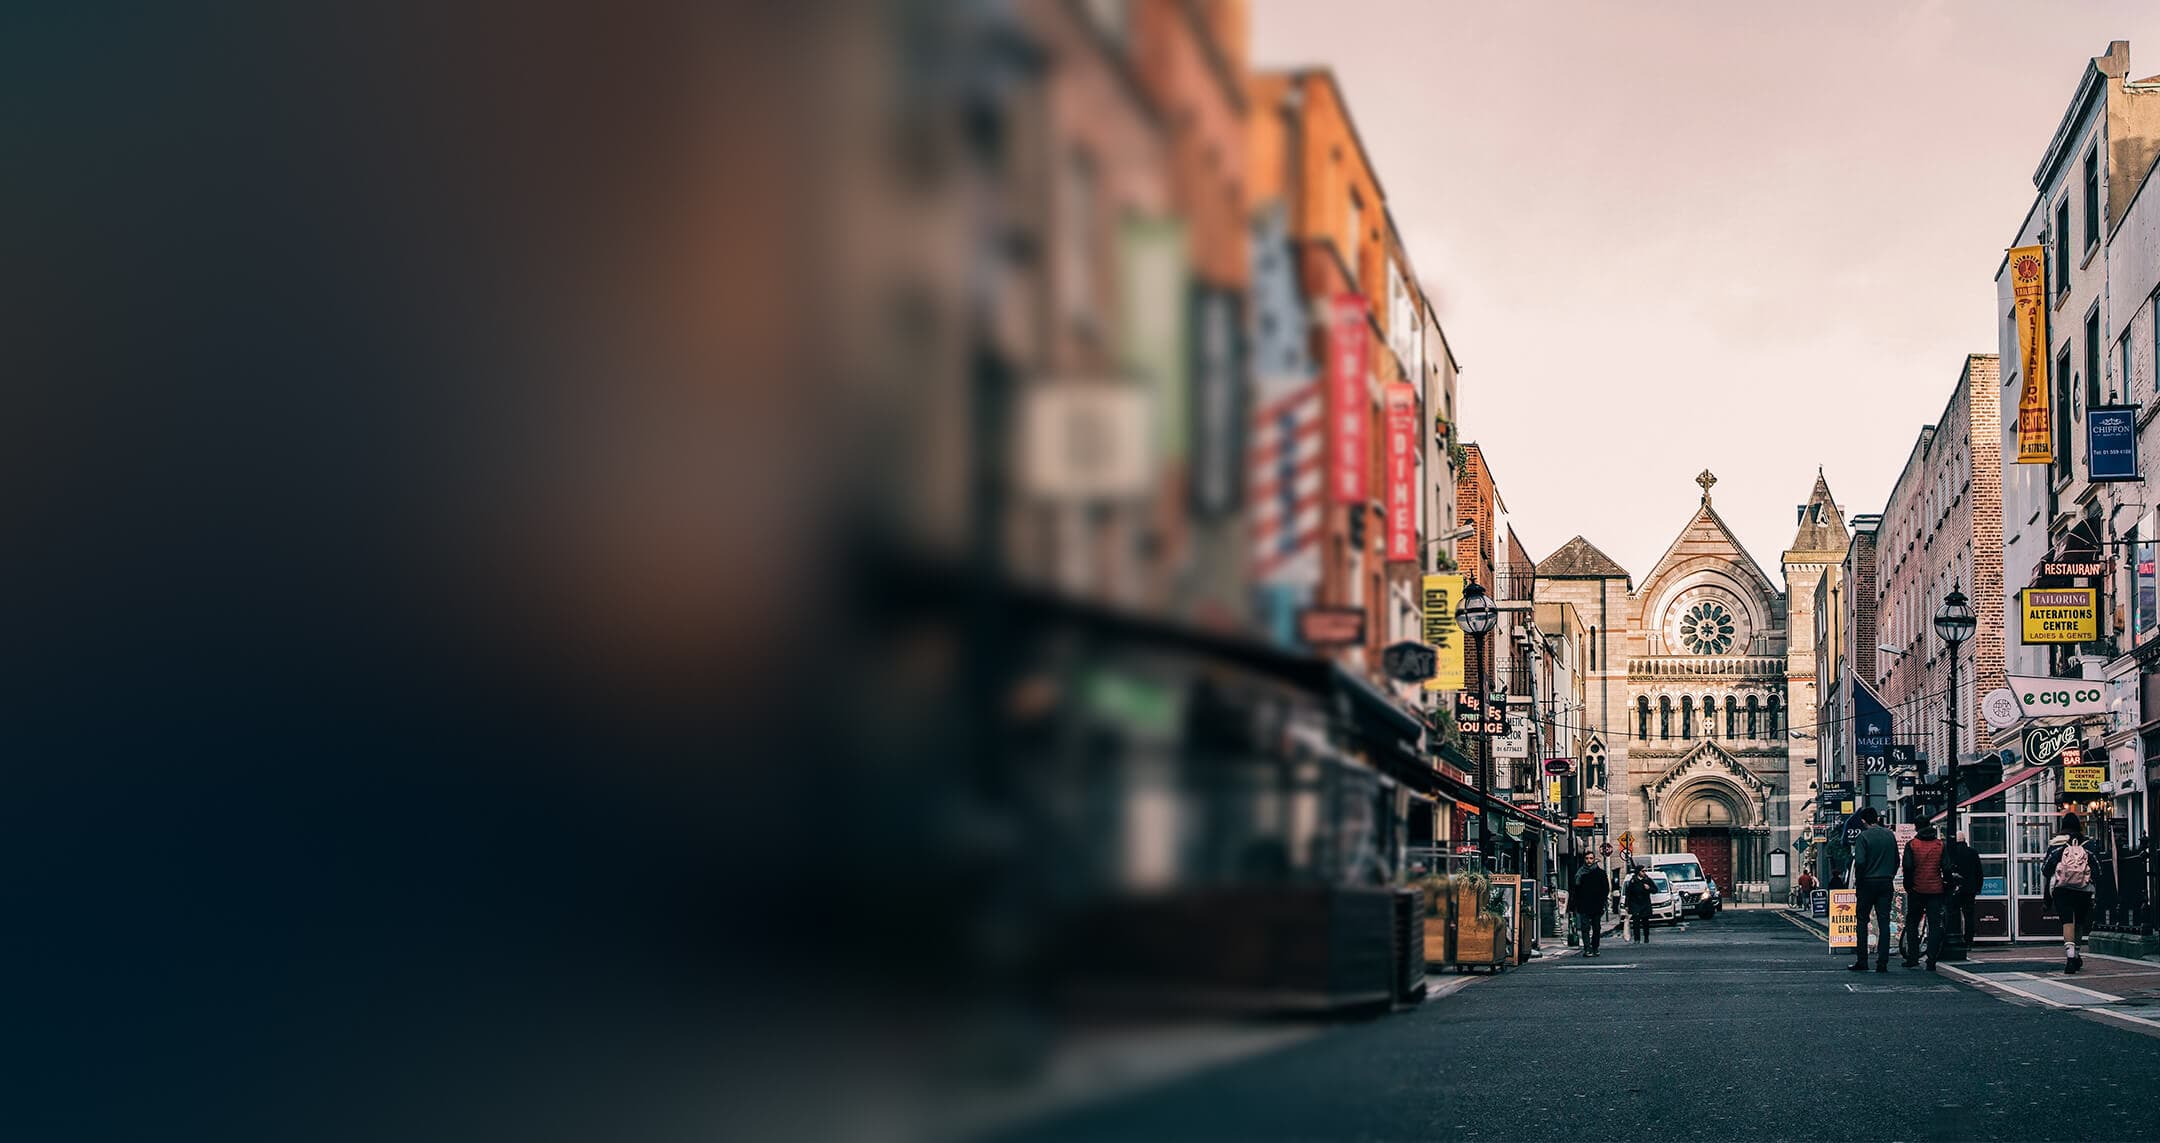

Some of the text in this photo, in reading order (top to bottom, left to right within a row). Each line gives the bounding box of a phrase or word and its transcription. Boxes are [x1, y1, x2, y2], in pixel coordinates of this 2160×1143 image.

[2028, 307, 2038, 404] ALTERATION
[2021, 411, 2048, 430] CENTRE
[1393, 432, 1409, 555] DINER
[2045, 563, 2101, 575] RESTAURANT
[2035, 595, 2086, 605] TAILORING
[2030, 610, 2092, 619] ALTERATIONS
[2043, 621, 2079, 630] CENTRE
[2024, 689, 2101, 707] e cig co
[1858, 737, 1891, 745] MAGEE
[1866, 756, 1886, 772] 22
[2063, 757, 2080, 765] BAR
[1847, 829, 1861, 838] 22
